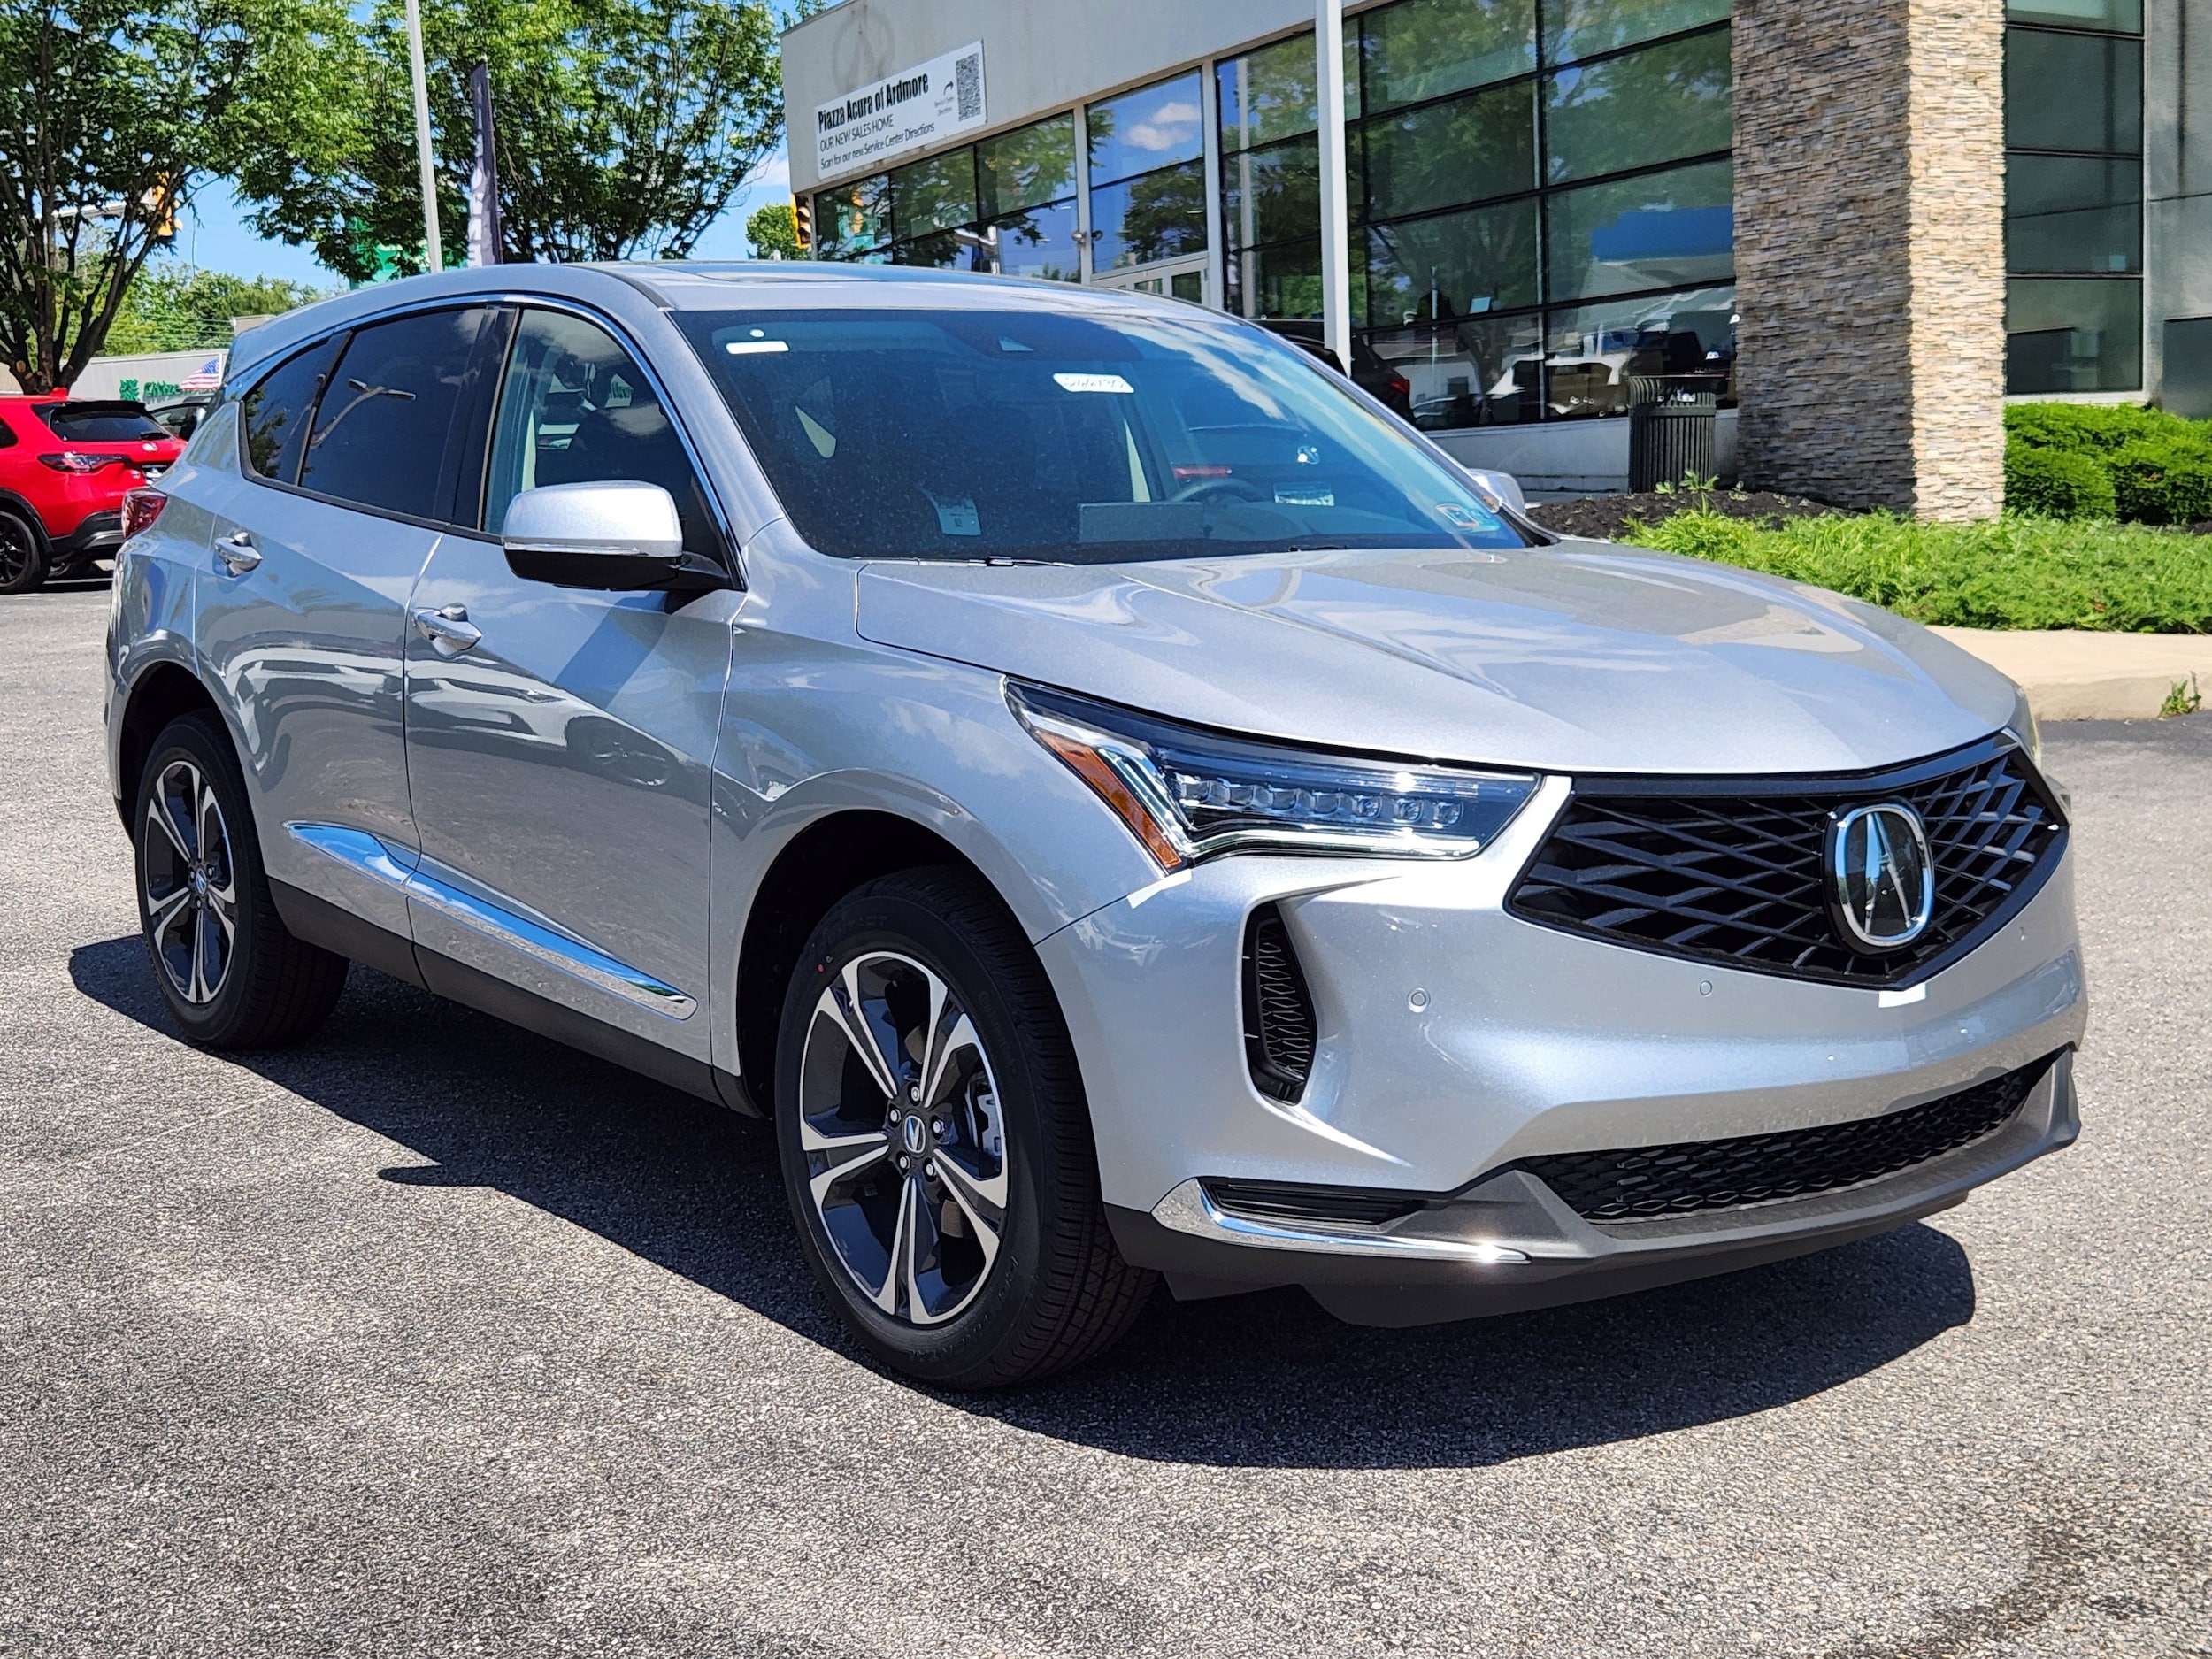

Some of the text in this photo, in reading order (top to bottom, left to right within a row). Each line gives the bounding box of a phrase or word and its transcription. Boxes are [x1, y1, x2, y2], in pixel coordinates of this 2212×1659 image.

[818, 106, 846, 134] Piazza
[846, 95, 873, 123] Acura
[874, 86, 885, 112] of
[886, 73, 929, 108] Ardmore
[819, 113, 894, 152] OUR NEW SALES HOME
[821, 157, 833, 170] Scan
[842, 151, 851, 163] our
[852, 148, 864, 158] new
[864, 140, 884, 155] Service
[885, 133, 904, 148] Center
[904, 122, 935, 142] Directions
